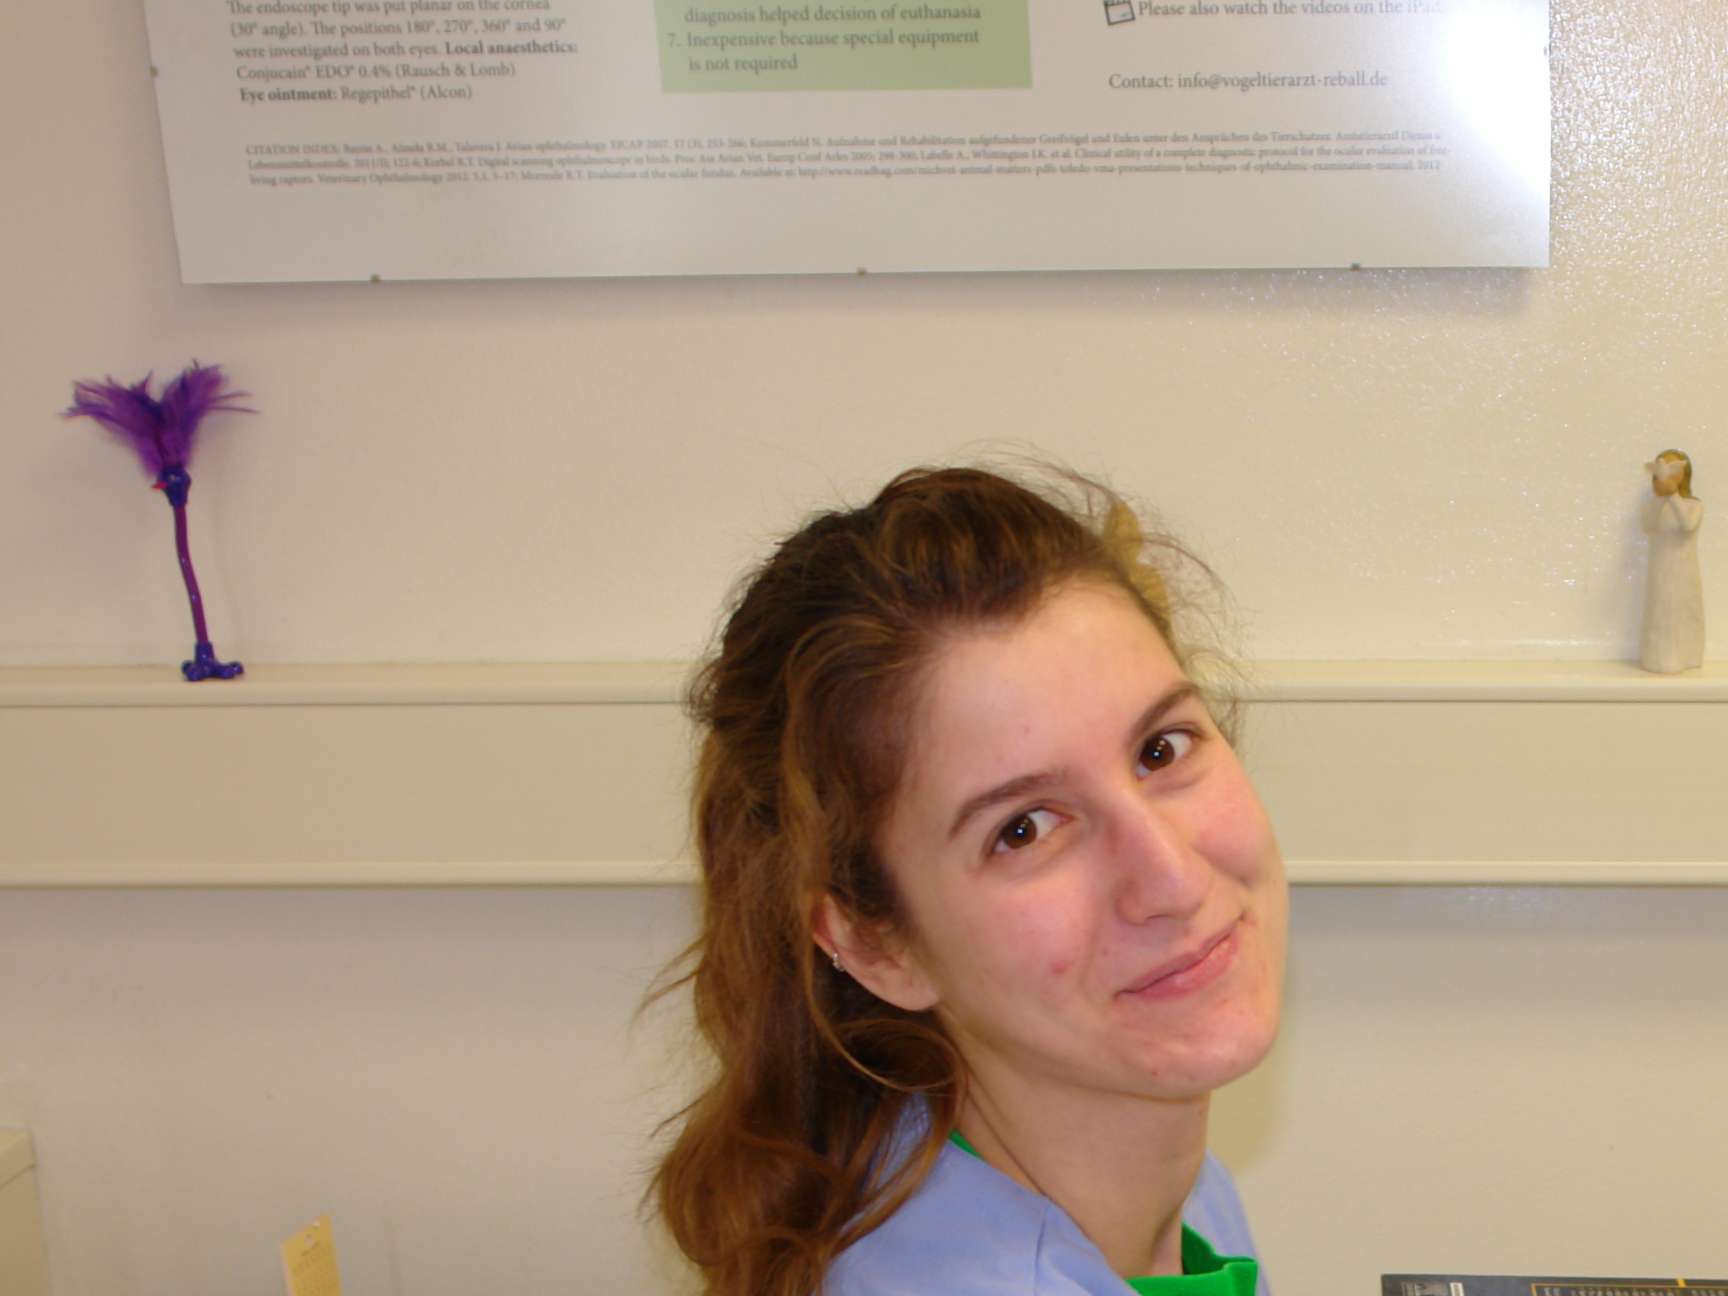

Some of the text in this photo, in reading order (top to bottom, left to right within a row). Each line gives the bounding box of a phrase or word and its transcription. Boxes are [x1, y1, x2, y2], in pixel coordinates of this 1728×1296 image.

[355, 2, 380, 12] was
[385, 0, 406, 14] put
[457, 1, 475, 10] on
[684, 2, 981, 27] diagnosis helped decision of euthanasia
[1138, 1, 1185, 16] Please
[1189, 0, 1219, 15] also
[1223, 0, 1268, 15] watch
[1272, 0, 1297, 14] the
[311, 20, 336, 35] The
[340, 21, 402, 37] positions
[515, 17, 541, 31] and
[687, 31, 777, 51] Inexpensive
[780, 29, 840, 45] because
[844, 28, 894, 48] special
[898, 29, 979, 50] equipment
[234, 47, 265, 57] were
[268, 43, 348, 60] investigated
[353, 46, 370, 56] on
[374, 41, 406, 56] both
[445, 40, 482, 54] Local
[688, 53, 798, 75] is not required
[1108, 72, 1174, 89] Contact:
[240, 87, 264, 104] Eye
[267, 86, 337, 101] ointment:
[420, 84, 472, 101] (Alcon)
